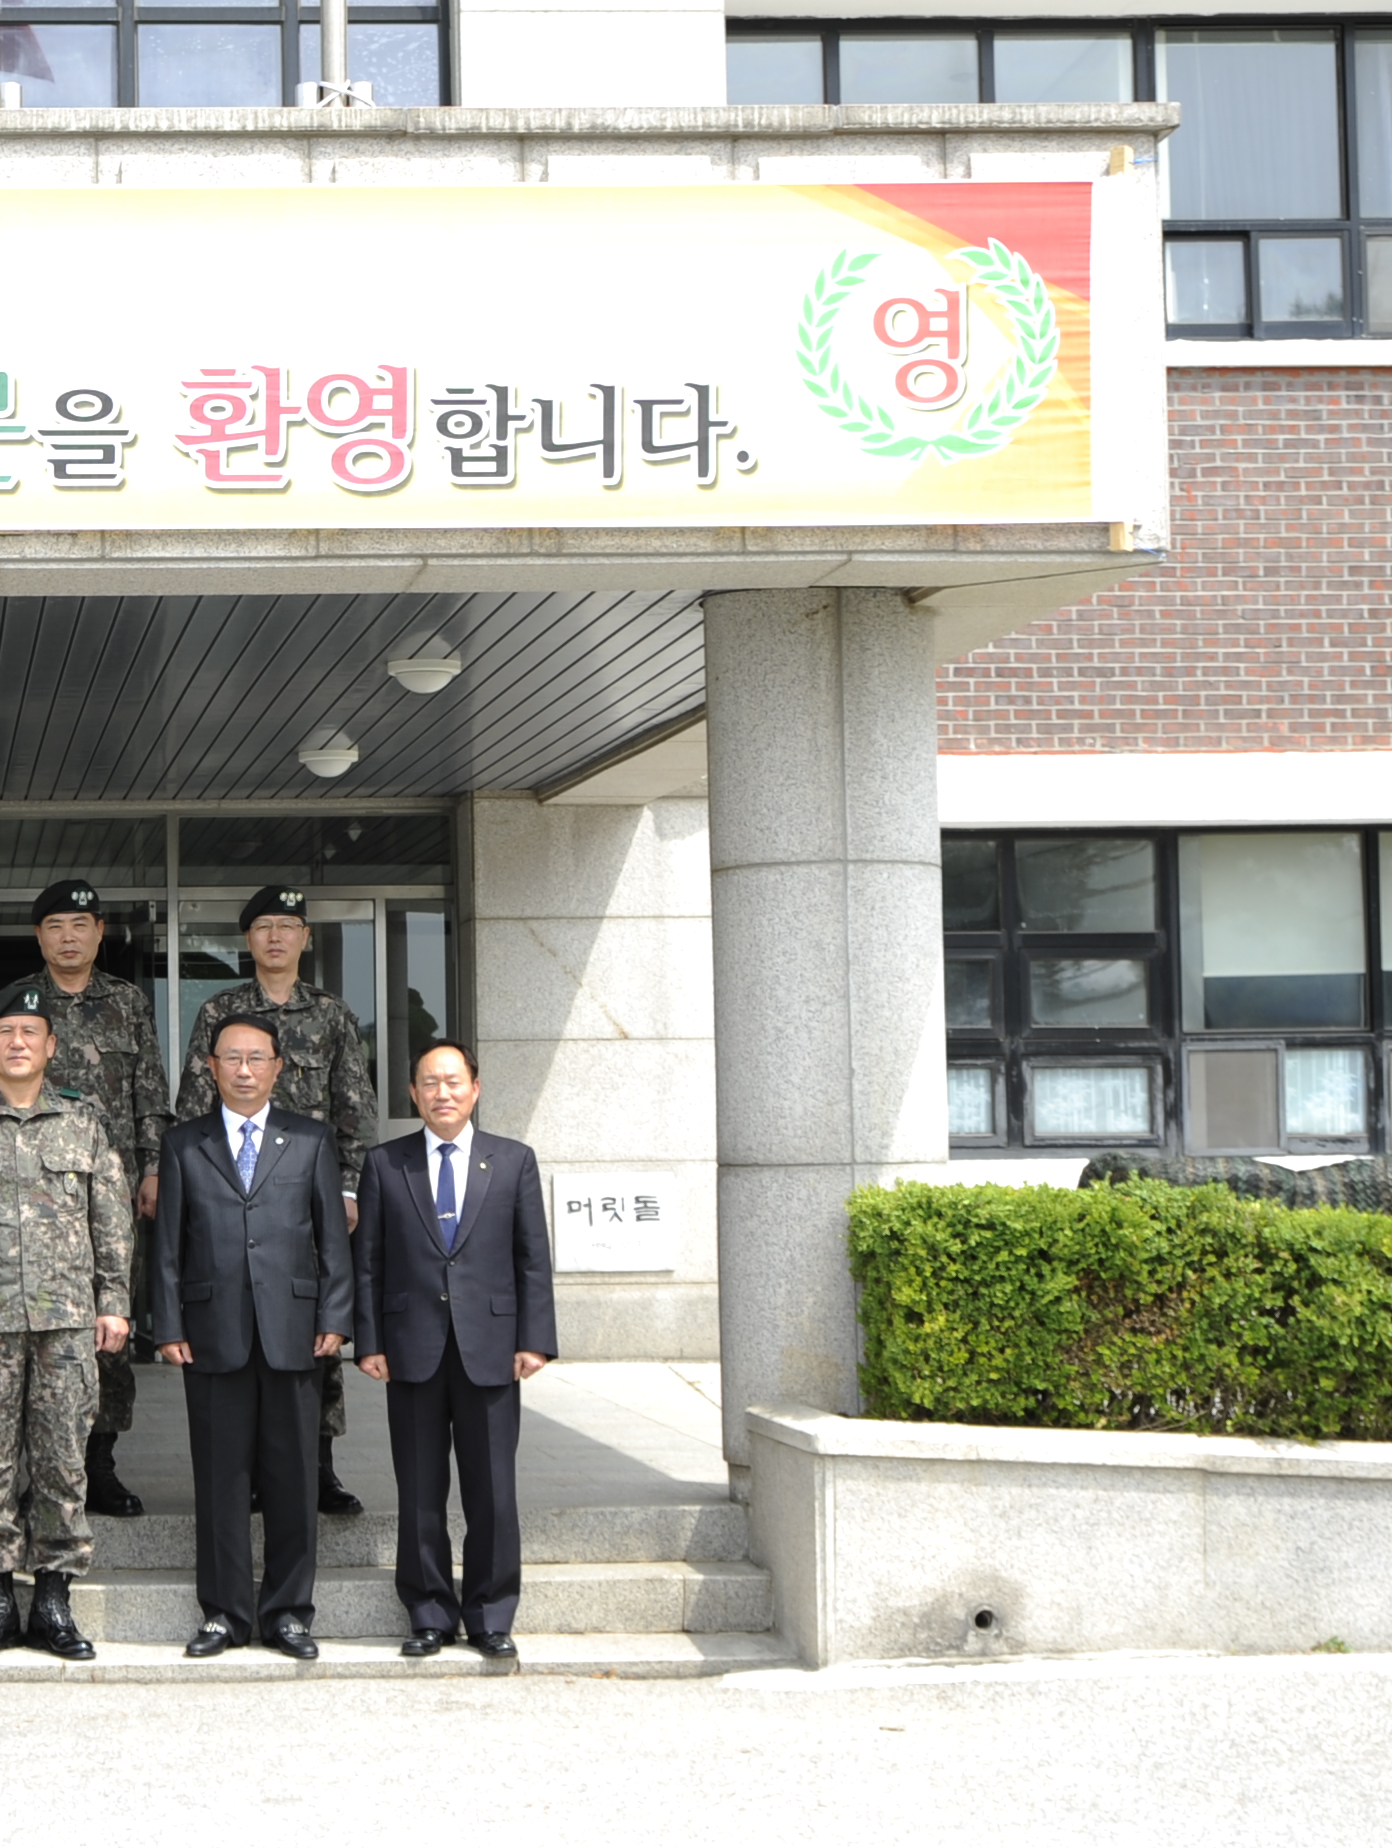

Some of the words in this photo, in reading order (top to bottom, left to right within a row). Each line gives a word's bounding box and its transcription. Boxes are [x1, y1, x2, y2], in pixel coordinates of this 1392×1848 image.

[873, 288, 961, 399] 영
[175, 364, 752, 486] 환영합니다.
[566, 1195, 661, 1227] 머릿돌
